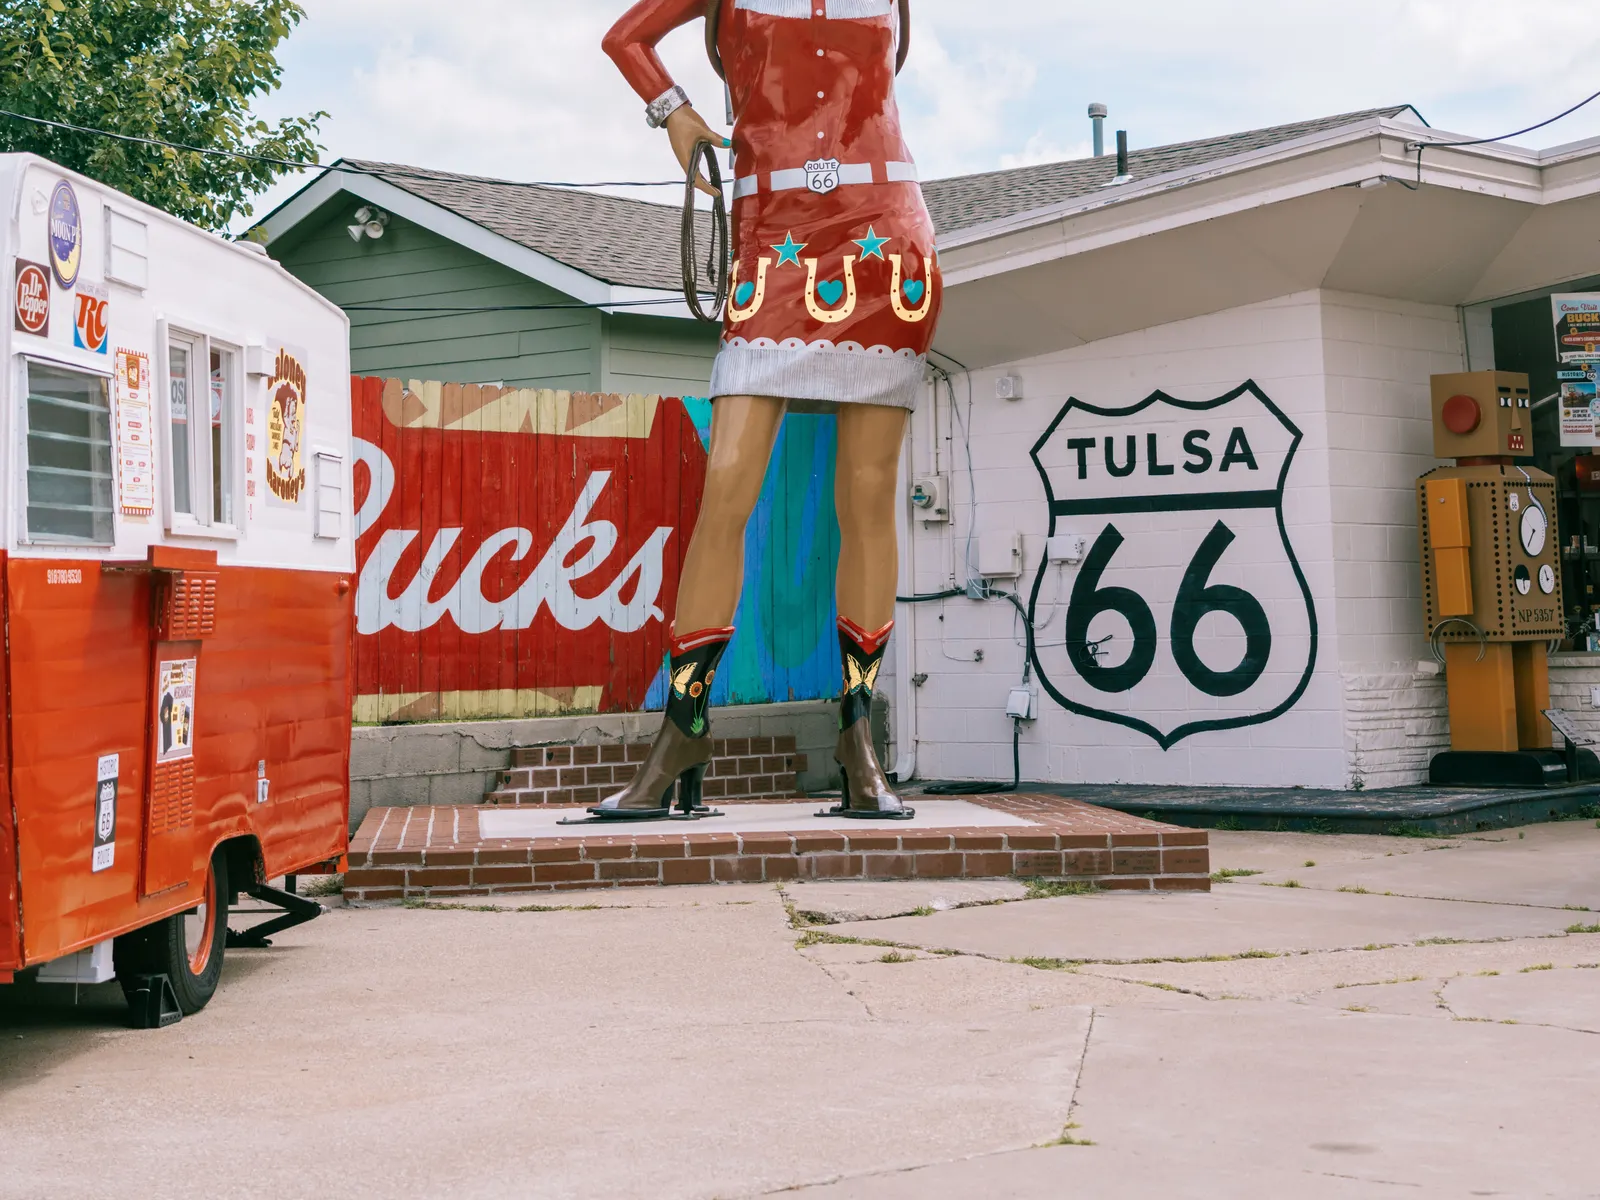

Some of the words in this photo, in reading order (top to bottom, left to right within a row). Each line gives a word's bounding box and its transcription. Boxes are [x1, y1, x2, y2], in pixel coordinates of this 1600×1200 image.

[807, 162, 836, 171] ROUTE
[812, 172, 834, 189] 66
[29, 272, 42, 297] Dr
[19, 282, 47, 322] Pepper
[1561, 304, 1579, 312] Come
[1580, 303, 1598, 311] Visit
[75, 292, 109, 349] RC
[267, 348, 307, 404] aloney
[1067, 426, 1259, 480] TULSA
[266, 458, 306, 503] Maroney's
[1066, 518, 1272, 697] 66
[1518, 609, 1533, 623] NP
[1534, 608, 1555, 622] 5357
[101, 812, 111, 832] 66
